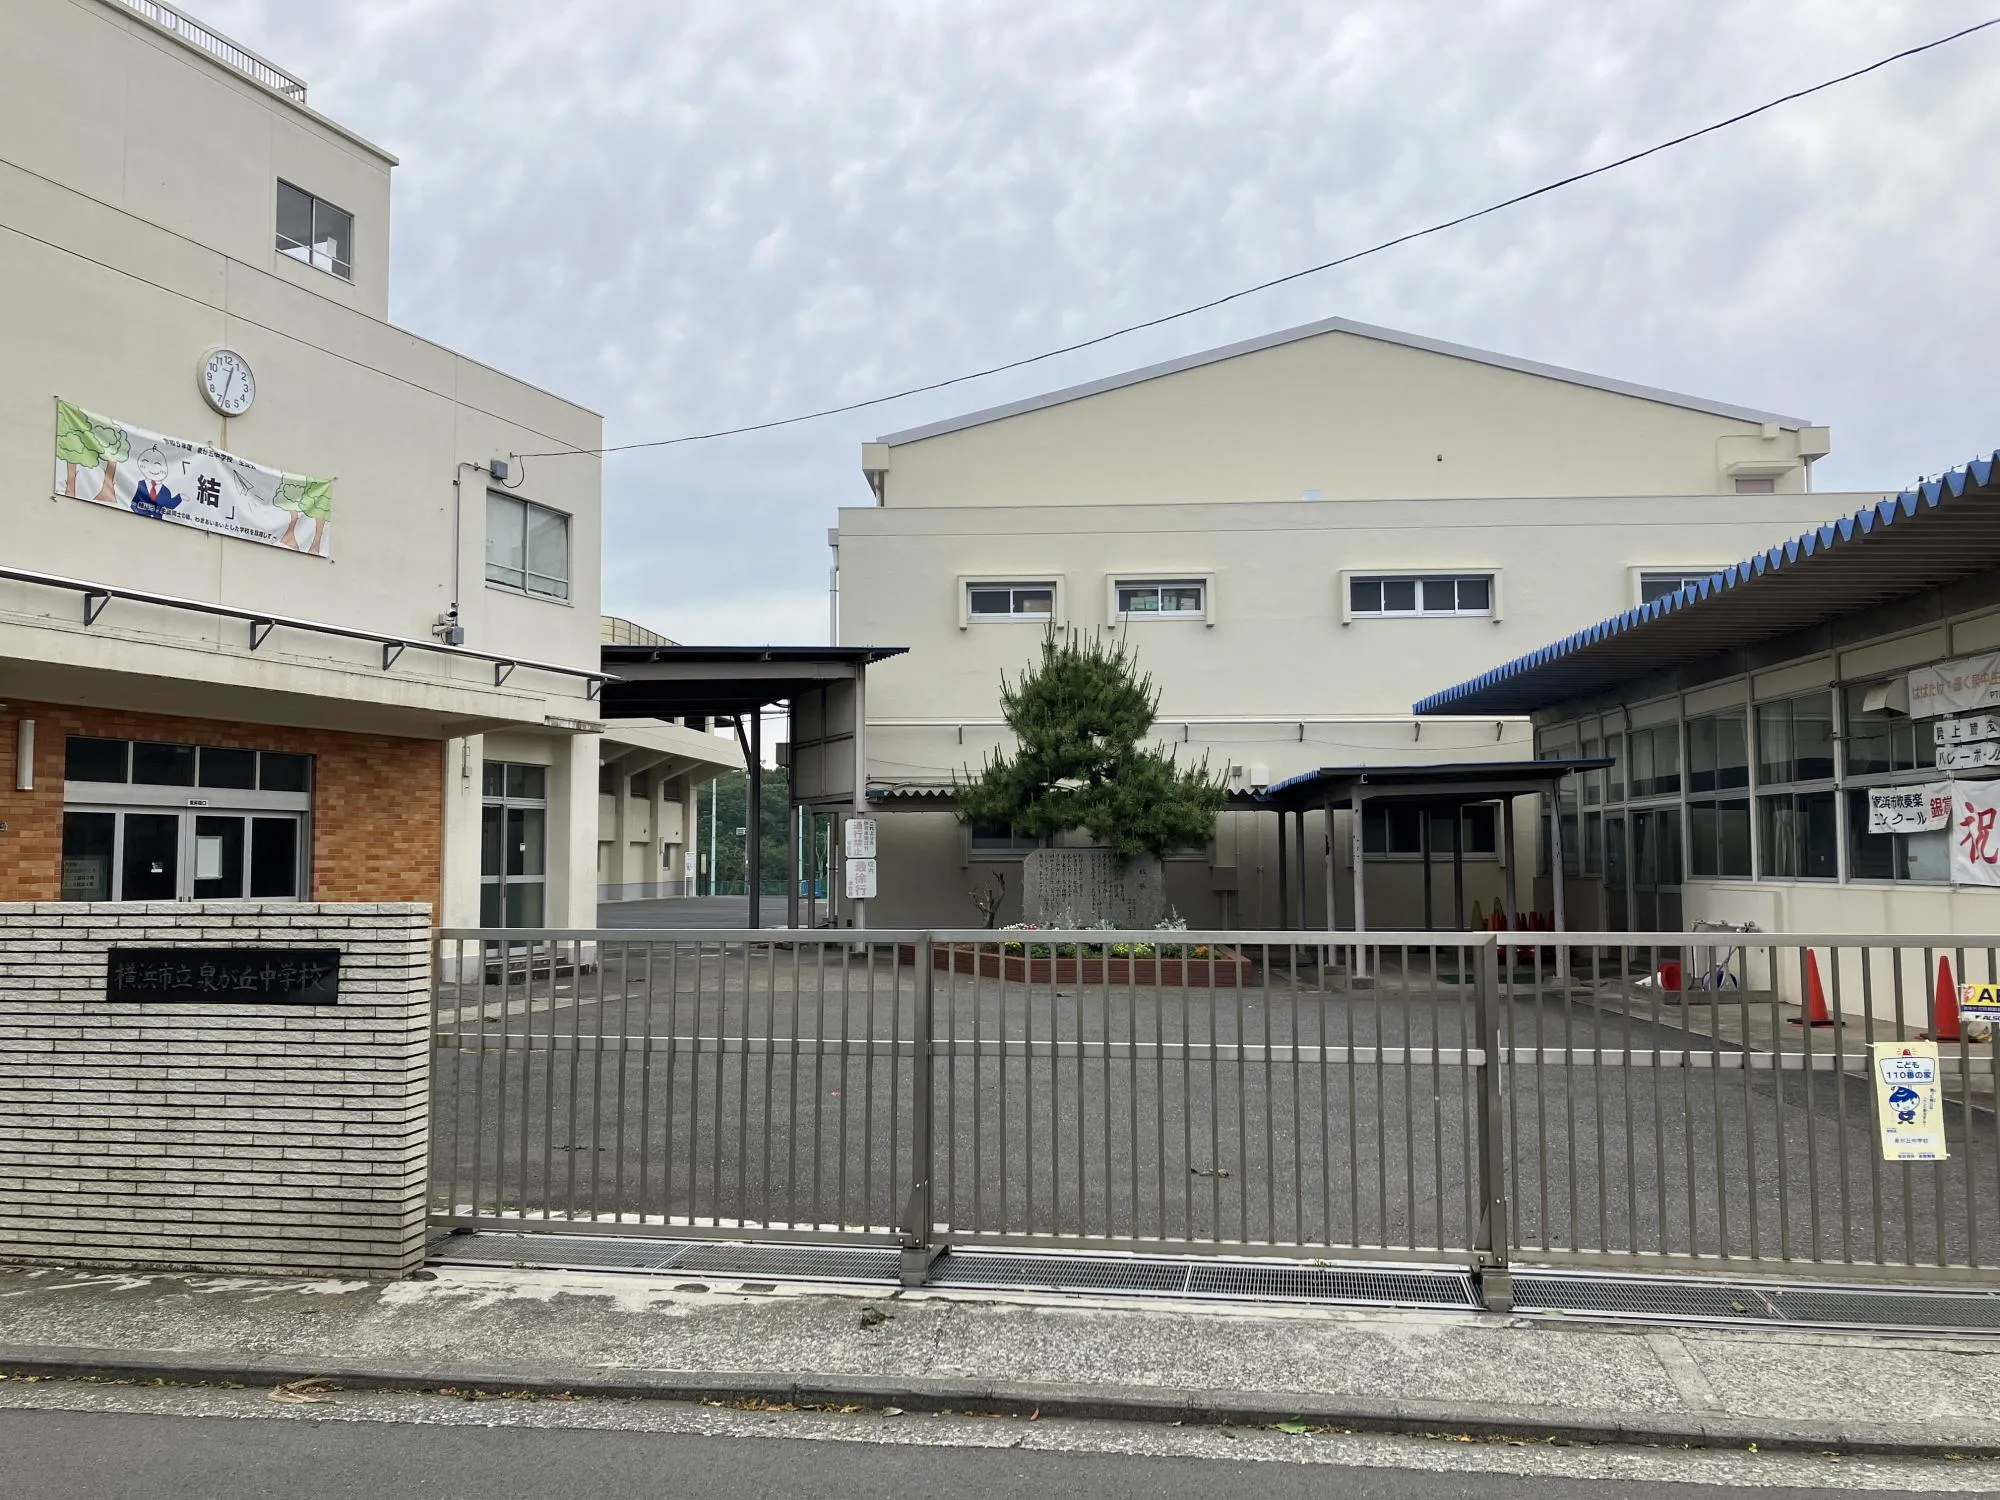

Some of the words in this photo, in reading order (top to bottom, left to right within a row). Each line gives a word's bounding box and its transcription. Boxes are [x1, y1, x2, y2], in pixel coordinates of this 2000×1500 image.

[215, 356, 223, 365] 11
[224, 356, 232, 366] 12
[209, 362, 218, 373] 10
[235, 363, 240, 372] 1
[206, 371, 213, 381] 9
[241, 371, 247, 382] 2
[209, 384, 216, 393] 8
[243, 384, 249, 393] 3
[216, 393, 223, 403] 7
[239, 394, 246, 403] 4
[224, 399, 231, 409] 6
[233, 399, 240, 409] 5
[1990, 690, 2000, 699] PT
[1960, 801, 1999, 865] 祝
[1978, 988, 2000, 1003] A
[1896, 1061, 1920, 1069] こども
[1886, 1071, 1931, 1079] 110番の家
